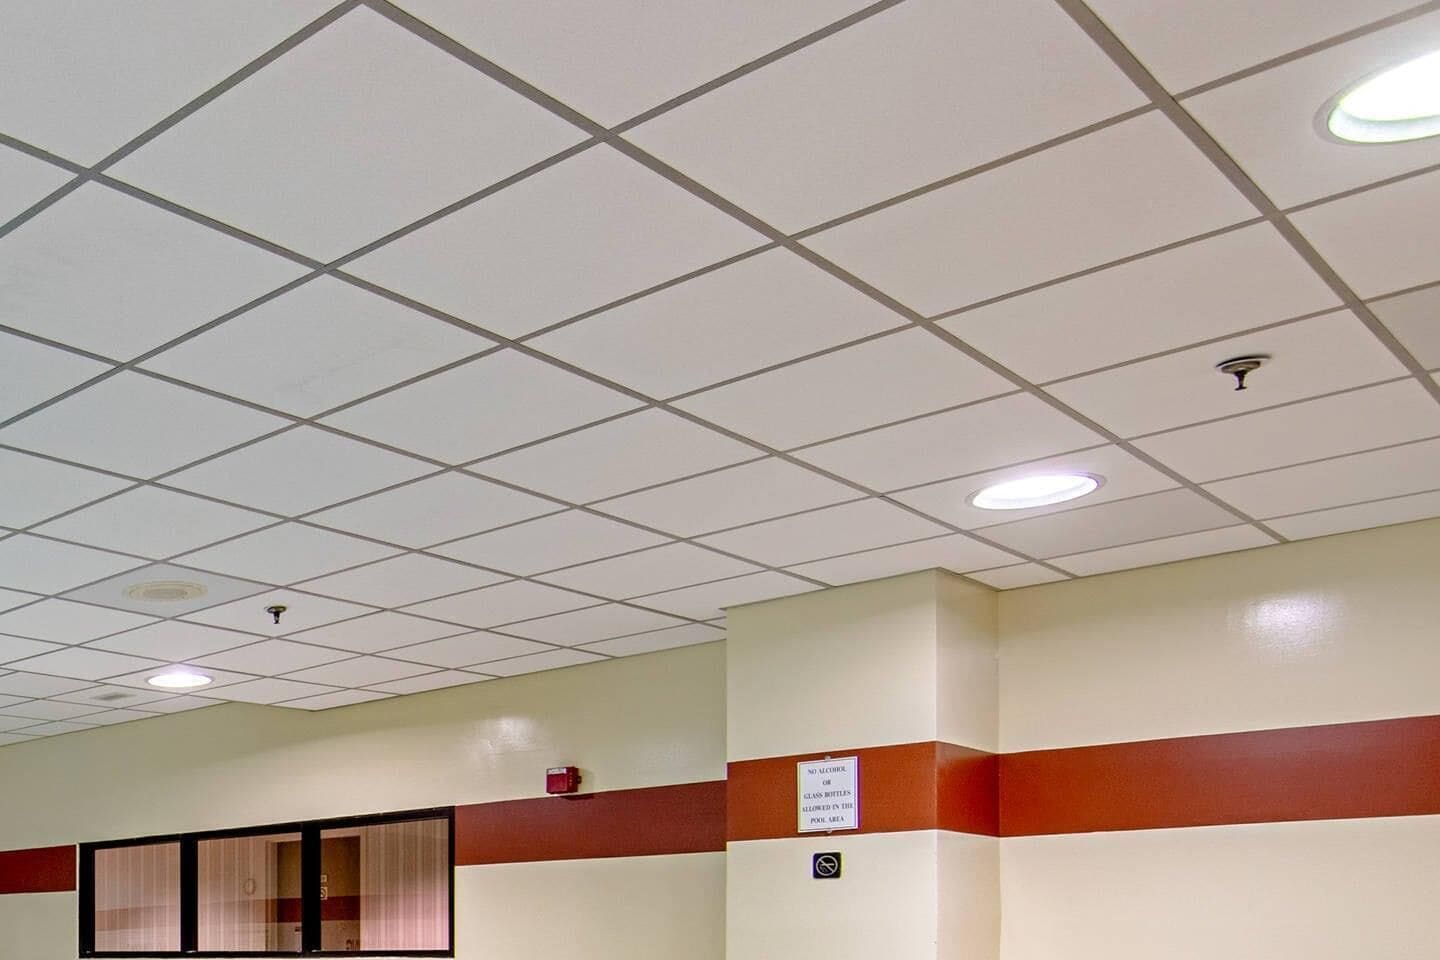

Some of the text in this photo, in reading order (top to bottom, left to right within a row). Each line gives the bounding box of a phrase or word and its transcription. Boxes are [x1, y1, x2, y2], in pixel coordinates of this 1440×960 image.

[819, 766, 847, 774] ALCOHOL
[824, 790, 851, 798] BOTTLES
[802, 804, 830, 812] ALLOWED
